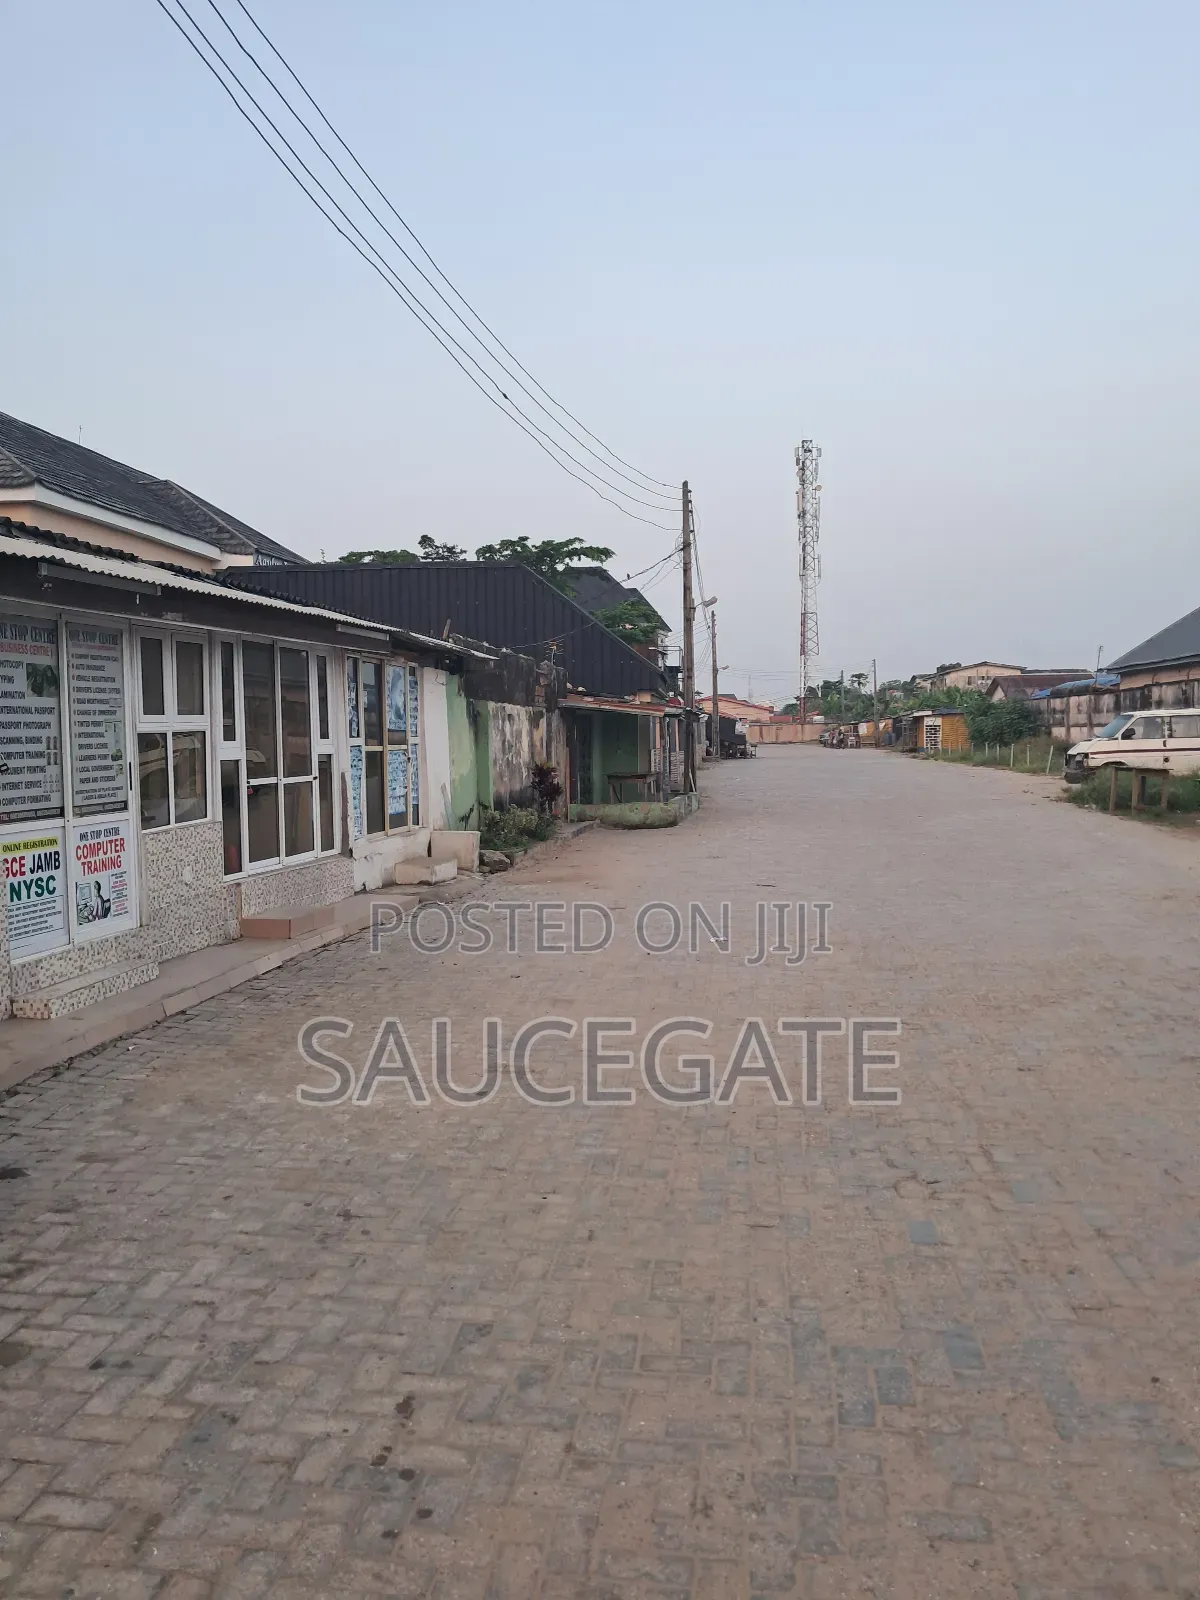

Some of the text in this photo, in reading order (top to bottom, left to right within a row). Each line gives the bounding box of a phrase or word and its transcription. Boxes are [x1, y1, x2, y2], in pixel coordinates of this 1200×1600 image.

[10, 623, 28, 641] STOP
[31, 626, 55, 644] CENTRE
[34, 706, 55, 715] PASSPORT
[23, 721, 52, 730] PHOTOGRAPH
[26, 751, 46, 760] TRAINING
[2, 780, 42, 792] INTERNET SERVICE
[2, 796, 26, 807] COMPUTER
[80, 827, 120, 842] ONE STOP CENTRE
[3, 838, 58, 852] ONLINE REGISTRATION
[76, 838, 125, 861] COMPUTER
[29, 851, 60, 875] JAMB
[81, 855, 122, 876] TRAINING
[9, 875, 56, 902] NYSC
